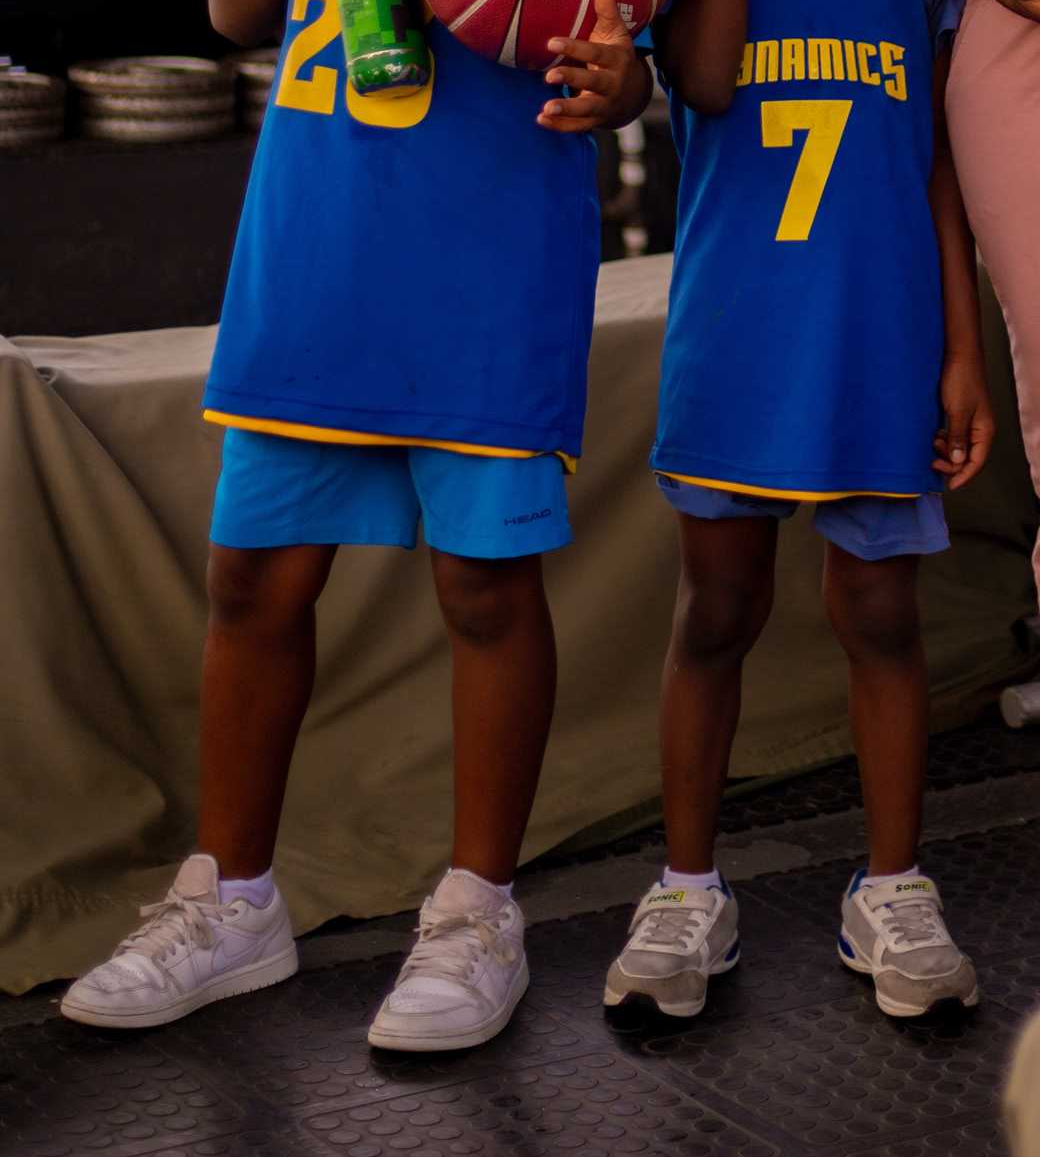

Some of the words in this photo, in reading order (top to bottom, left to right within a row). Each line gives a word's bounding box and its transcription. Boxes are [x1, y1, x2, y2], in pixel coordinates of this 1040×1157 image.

[760, 99, 854, 242] 7
[503, 507, 552, 527] HEAD
[895, 883, 928, 893] SONIC
